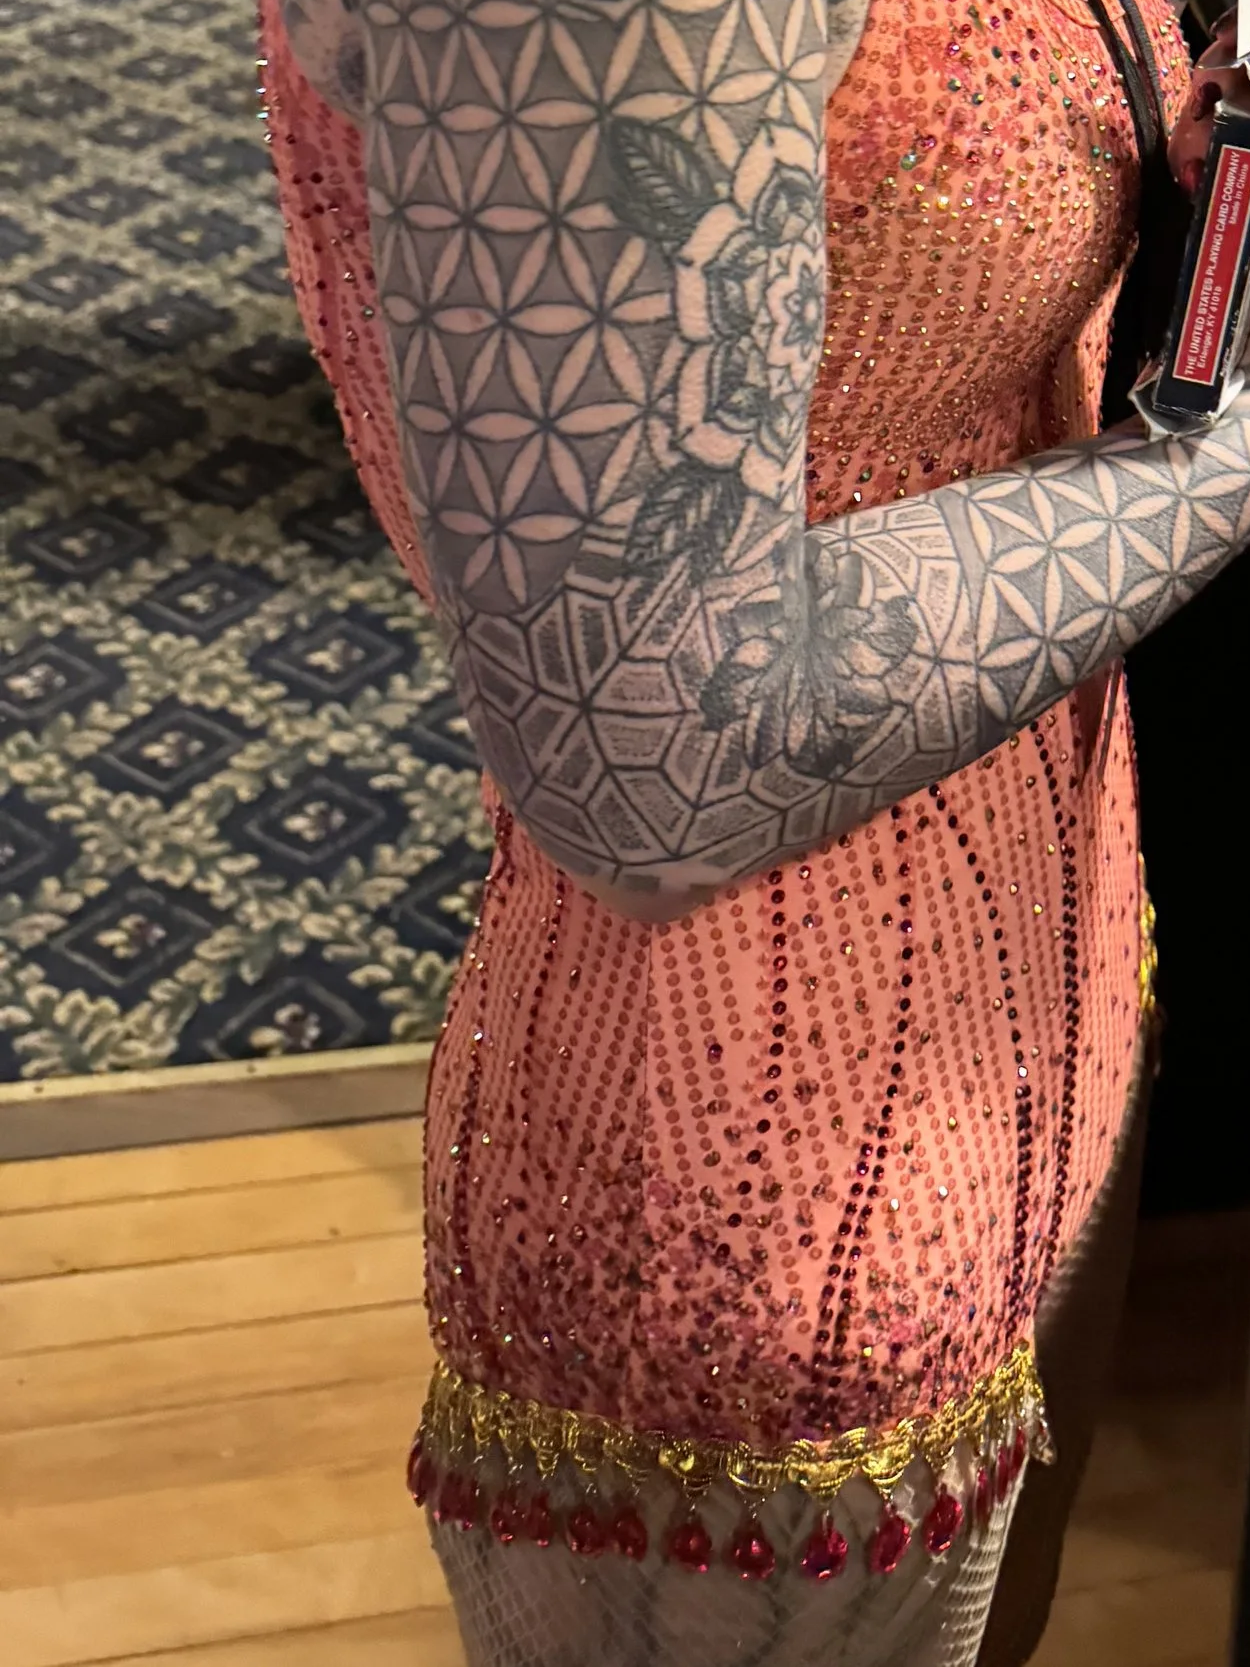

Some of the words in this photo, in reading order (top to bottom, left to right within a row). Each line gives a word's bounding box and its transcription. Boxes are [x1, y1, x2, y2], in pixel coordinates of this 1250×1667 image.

[1221, 151, 1241, 202] COMPANY
[1215, 202, 1229, 232] CARD
[1206, 231, 1224, 276] PLAYING
[1198, 277, 1214, 314] STATES
[1189, 317, 1205, 353] UNITED
[1206, 313, 1217, 327] KY
[1184, 355, 1198, 375] THE
